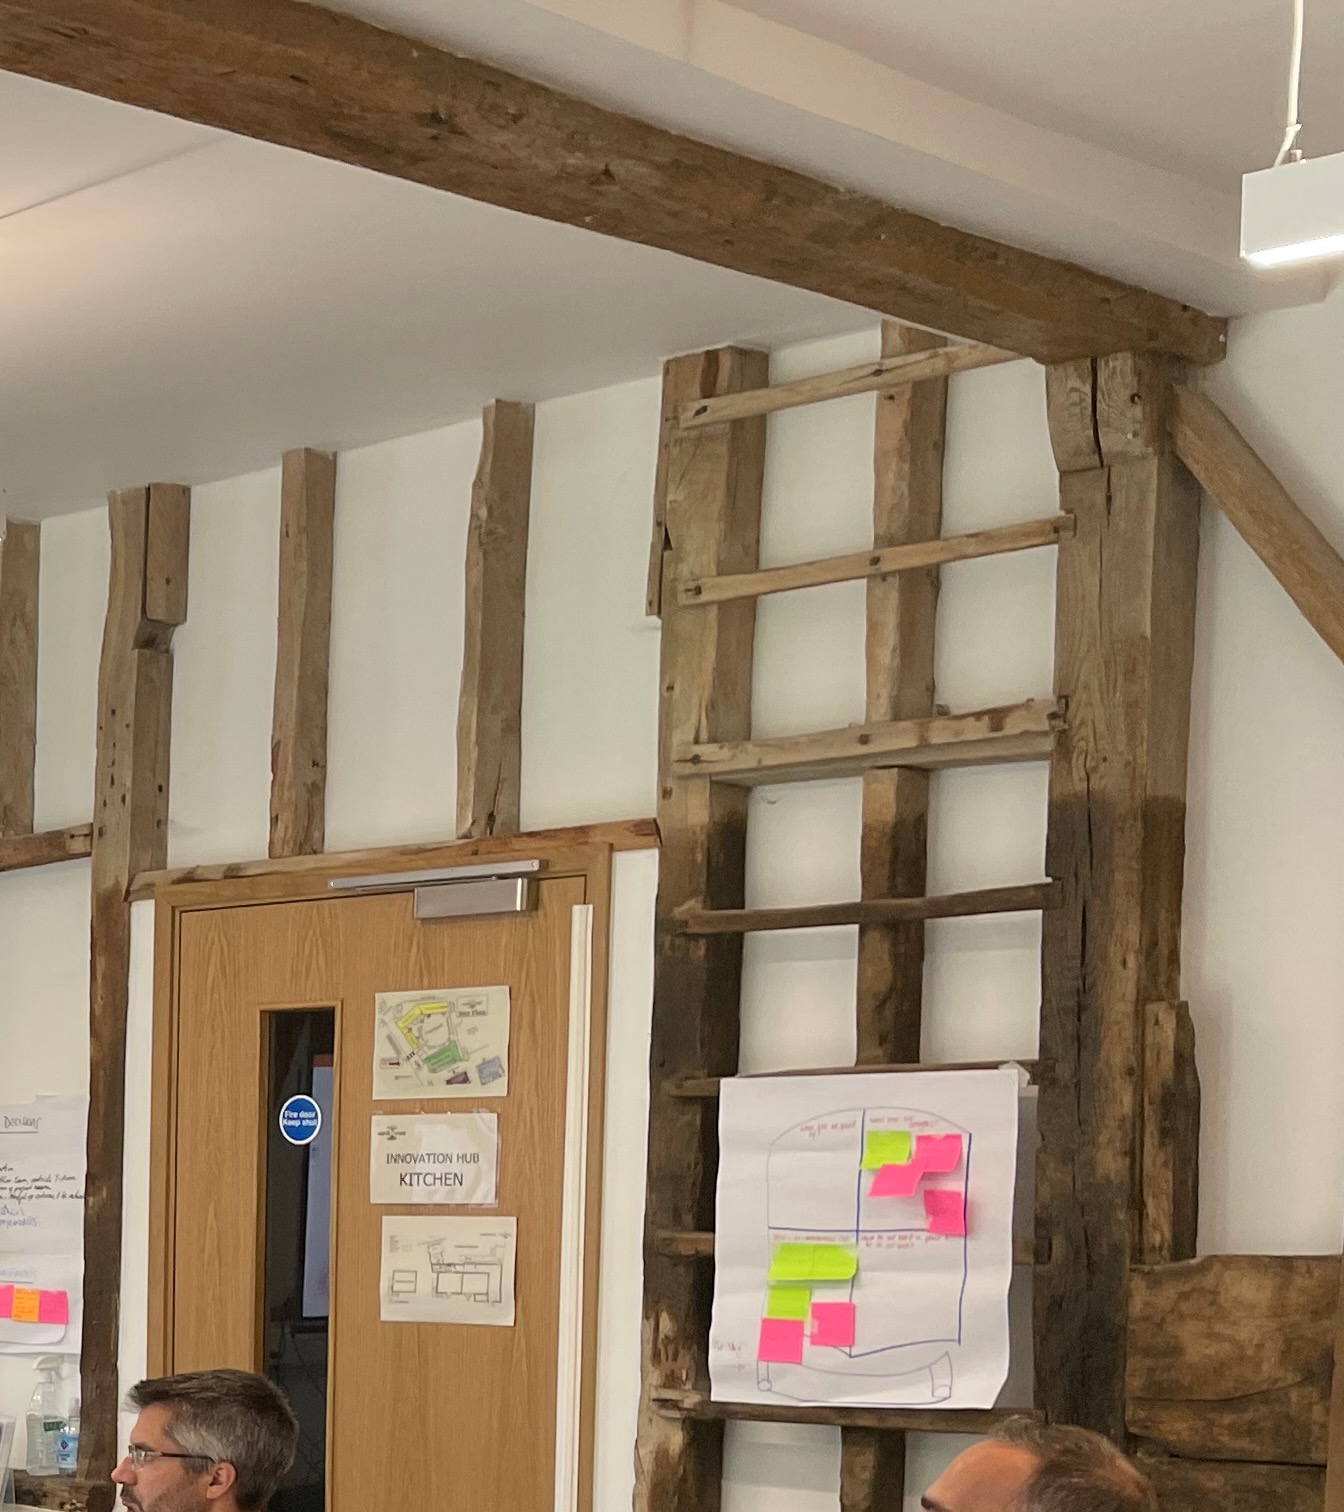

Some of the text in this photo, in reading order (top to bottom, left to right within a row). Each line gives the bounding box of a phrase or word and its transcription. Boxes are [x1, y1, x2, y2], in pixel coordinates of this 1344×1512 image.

[285, 1110, 298, 1118] Fire
[283, 1119, 301, 1127] Keep
[386, 1152, 480, 1165] INNOVATION HUB
[399, 1172, 464, 1187] KITCHEN
